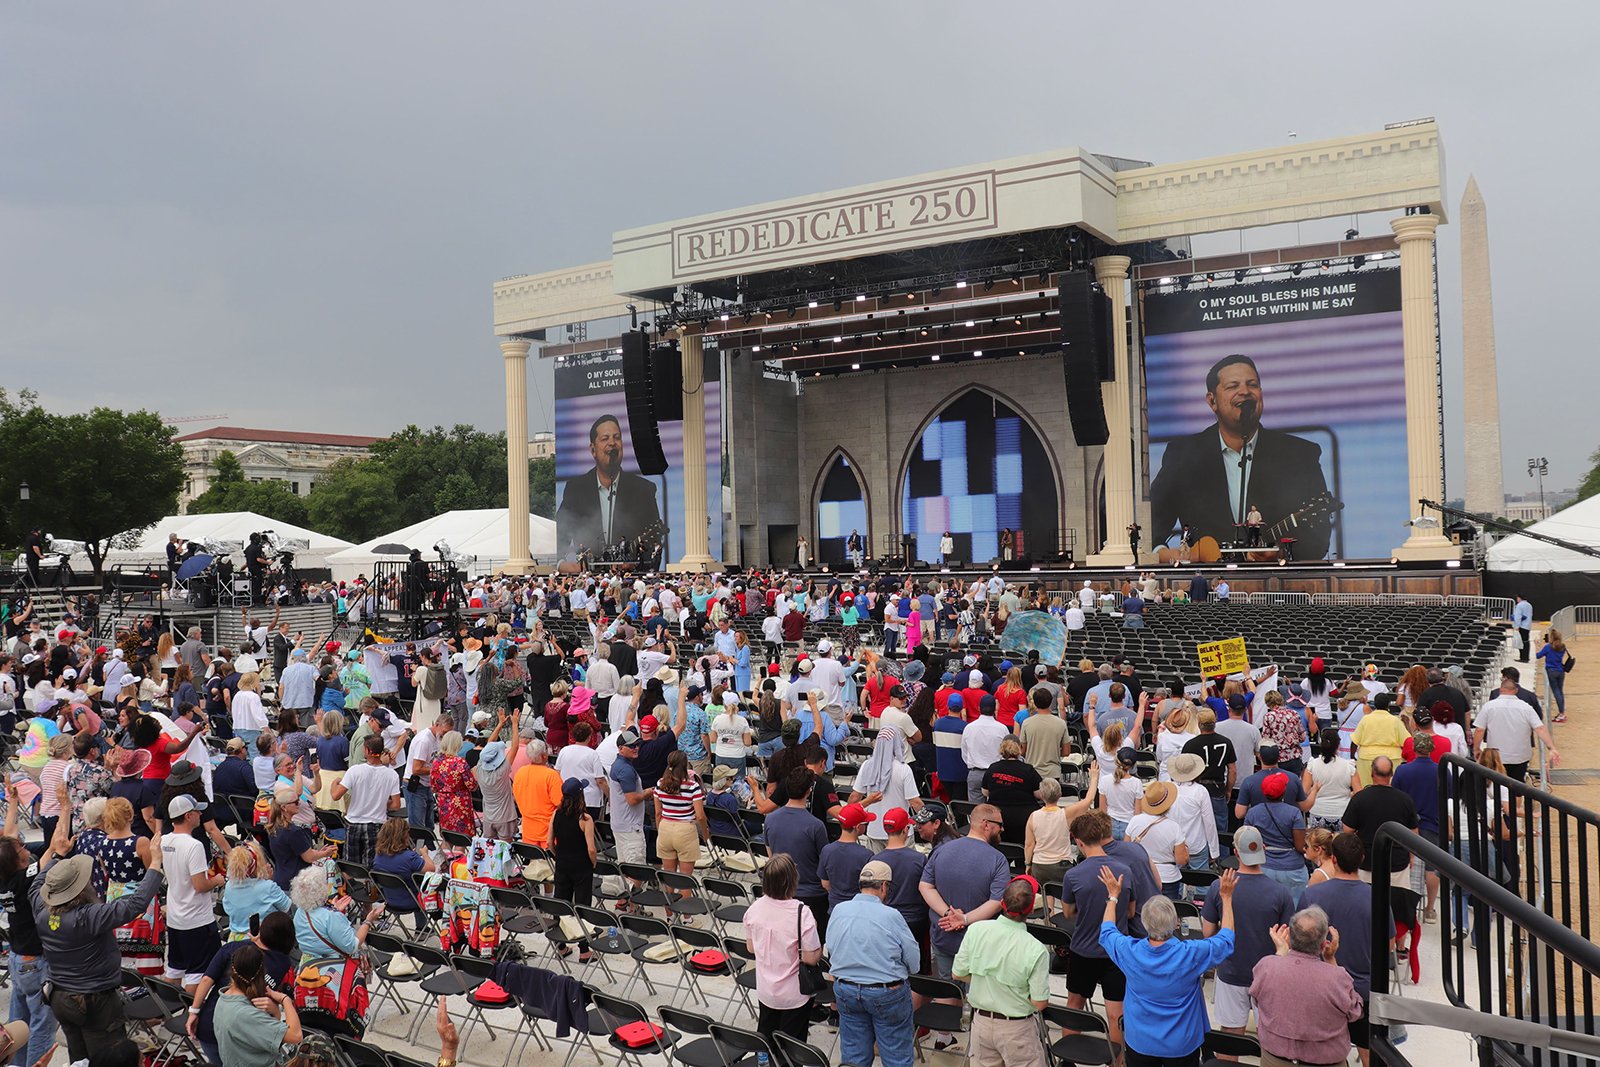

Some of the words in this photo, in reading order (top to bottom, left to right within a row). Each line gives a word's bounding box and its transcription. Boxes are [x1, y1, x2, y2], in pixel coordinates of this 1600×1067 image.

[687, 200, 896, 263] REDEDICATE
[909, 187, 976, 226] 250
[1199, 299, 1208, 309] O
[1210, 298, 1227, 308] MY
[1228, 295, 1259, 306] SOUL
[1261, 290, 1298, 302] BLESS
[1301, 287, 1320, 298] HIS
[1322, 284, 1357, 295] NAME
[1202, 312, 1224, 321] ALL
[1225, 308, 1254, 319] THAT
[1256, 306, 1267, 316] IS
[1269, 302, 1309, 315] WITHIN
[1312, 300, 1330, 310] ME
[1332, 297, 1355, 309] SAY
[588, 381, 601, 389] ALL
[602, 379, 619, 387] THAT
[604, 369, 622, 377] SOUL
[1200, 645, 1220, 653] BELIEVE
[1203, 743, 1227, 767] 17
